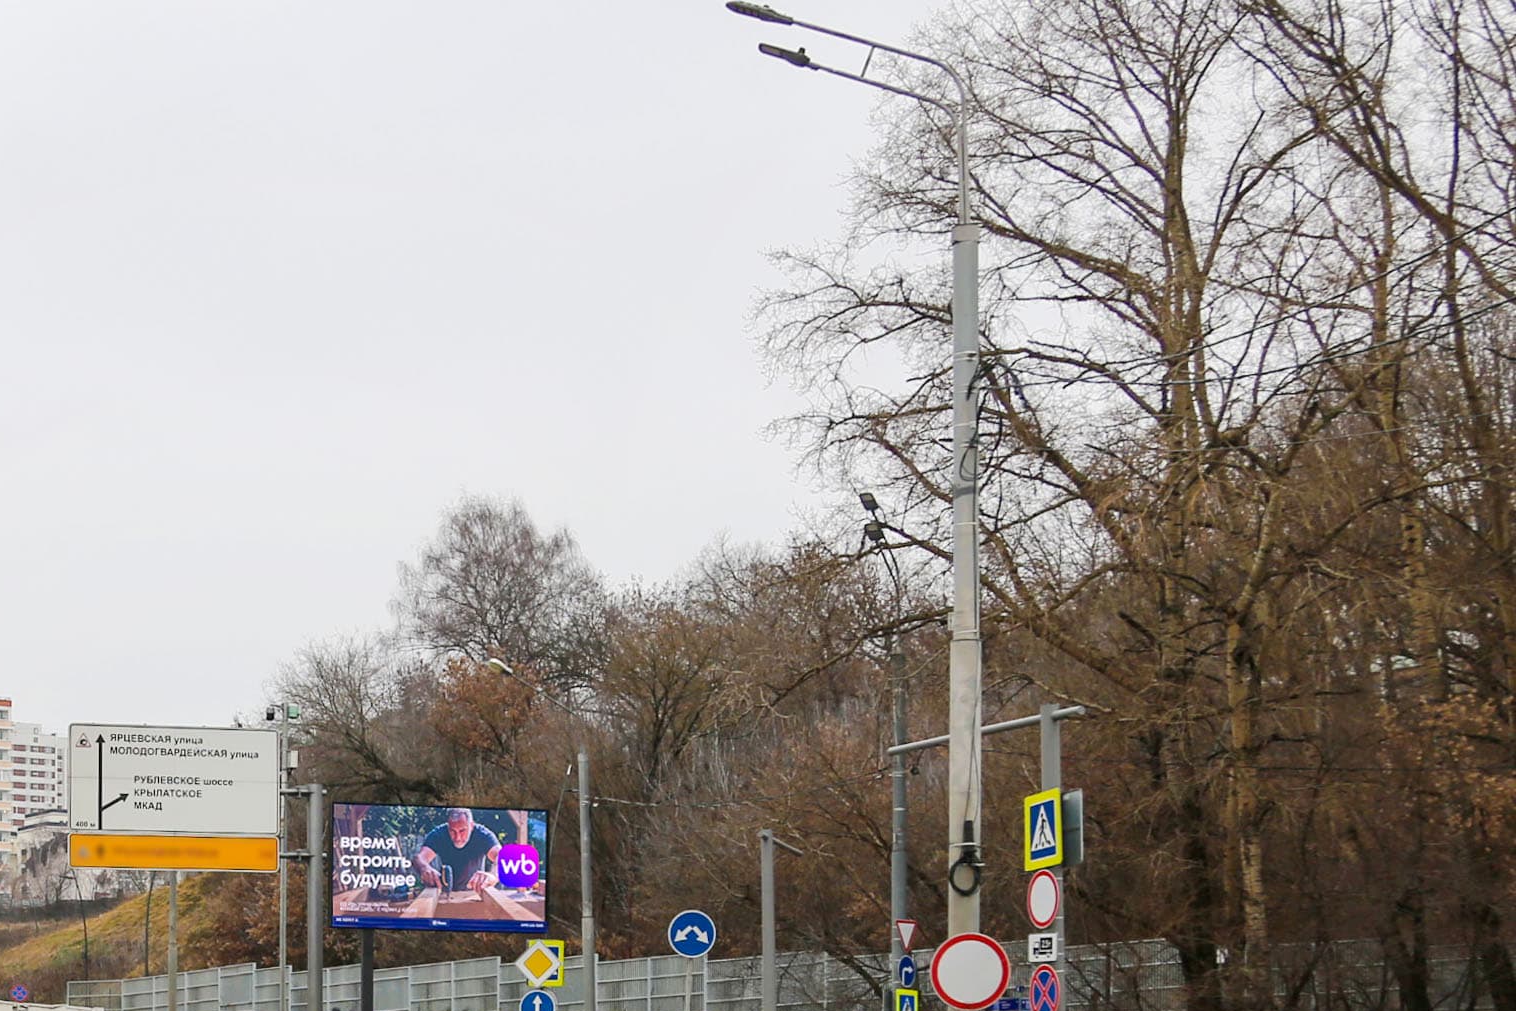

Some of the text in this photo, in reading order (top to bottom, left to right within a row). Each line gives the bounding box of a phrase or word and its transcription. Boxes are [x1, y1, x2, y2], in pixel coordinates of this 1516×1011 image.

[109, 733, 204, 746] ЯРЦЕВСКАЯ улица
[230, 751, 260, 761] улица
[133, 775, 234, 787] РУБЛЕВСКОЕ шоссе
[133, 788, 203, 799] КРЫЛАТСКОЕ
[133, 801, 163, 811] МКАД
[340, 836, 397, 852] время
[340, 854, 412, 870] строить
[500, 853, 537, 876] wb
[340, 869, 416, 889] будущее
